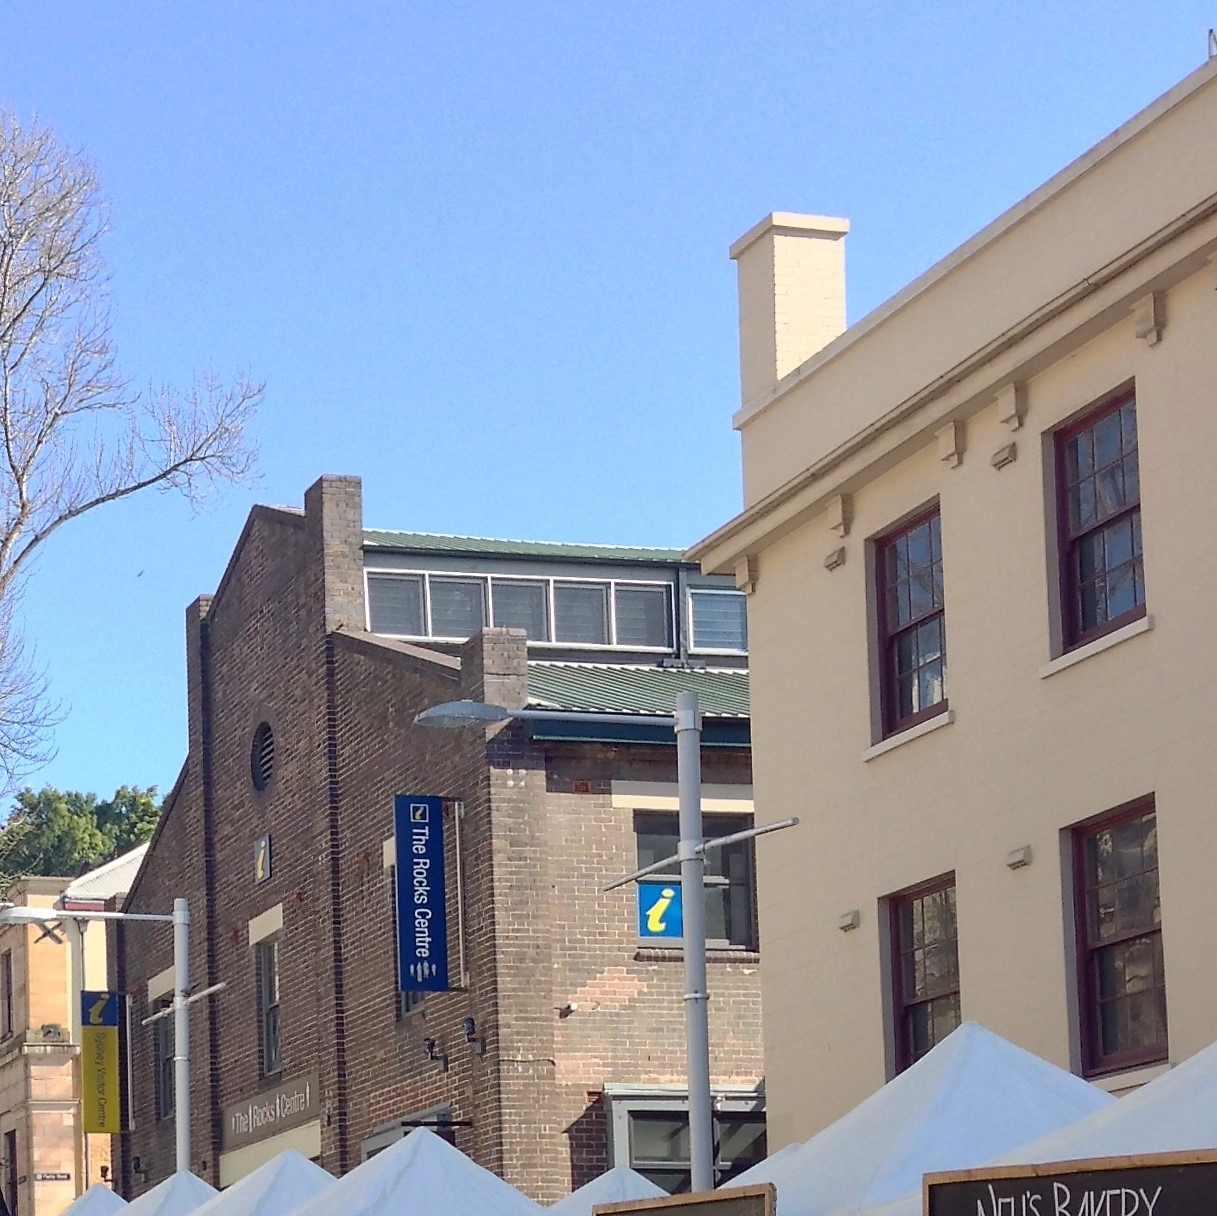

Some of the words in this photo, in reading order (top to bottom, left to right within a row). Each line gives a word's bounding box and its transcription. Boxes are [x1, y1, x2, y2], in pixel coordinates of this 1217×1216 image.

[411, 826, 429, 854] The
[413, 858, 431, 905] Rocks
[414, 908, 432, 958] Centre
[235, 1112, 249, 1135] The
[253, 1104, 275, 1128] Rocks
[280, 1090, 305, 1118] Centre
